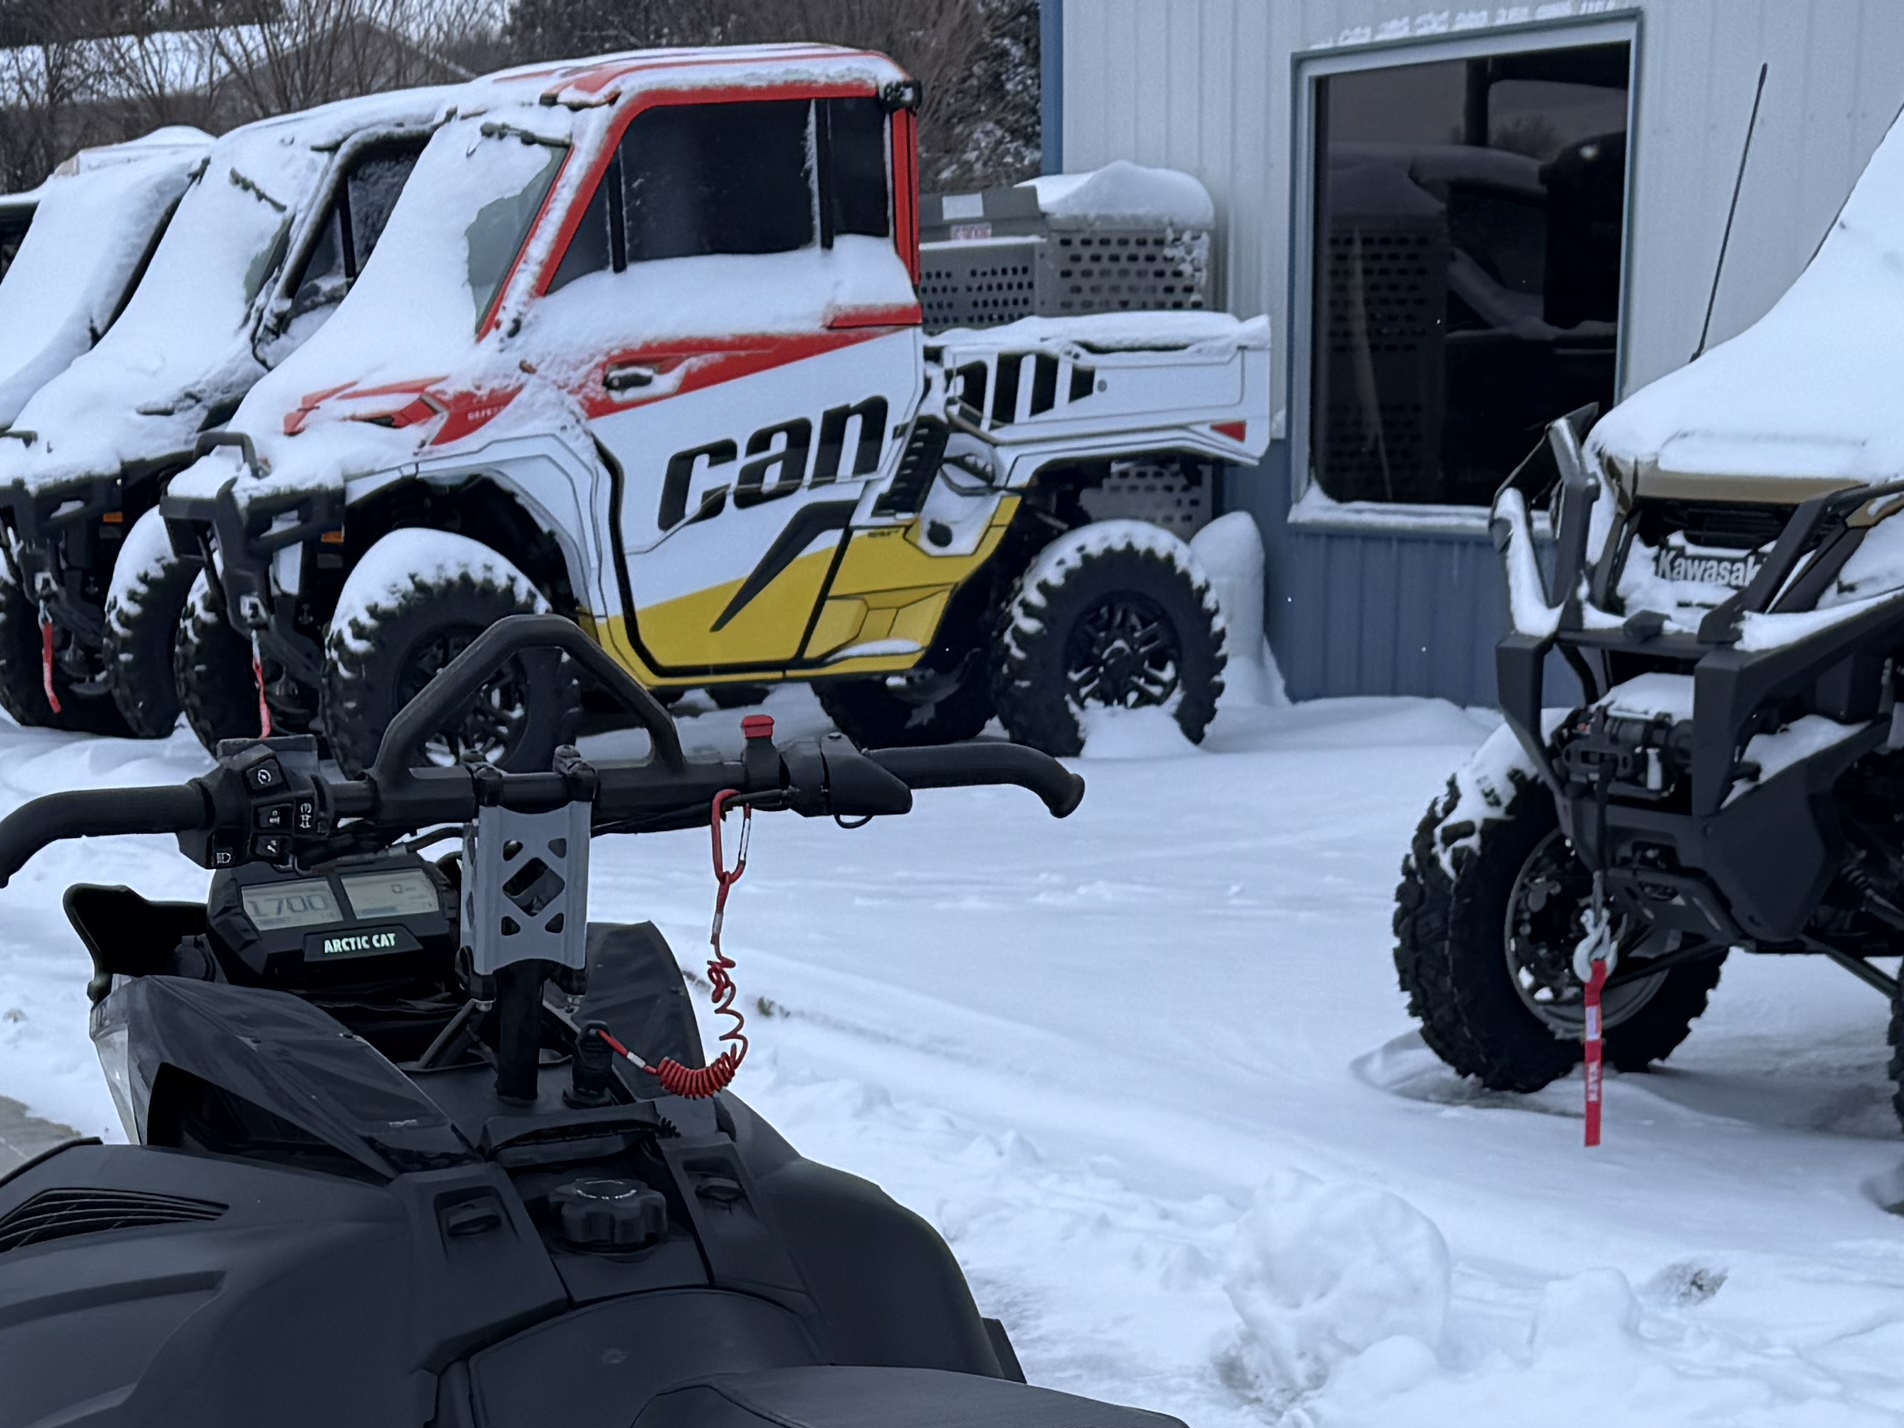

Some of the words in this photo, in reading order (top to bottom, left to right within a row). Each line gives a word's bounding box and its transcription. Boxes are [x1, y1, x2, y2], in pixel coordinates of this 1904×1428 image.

[1658, 548, 1768, 587] Kawasak
[323, 935, 370, 954] ARCTIC
[372, 933, 396, 948] CAT
